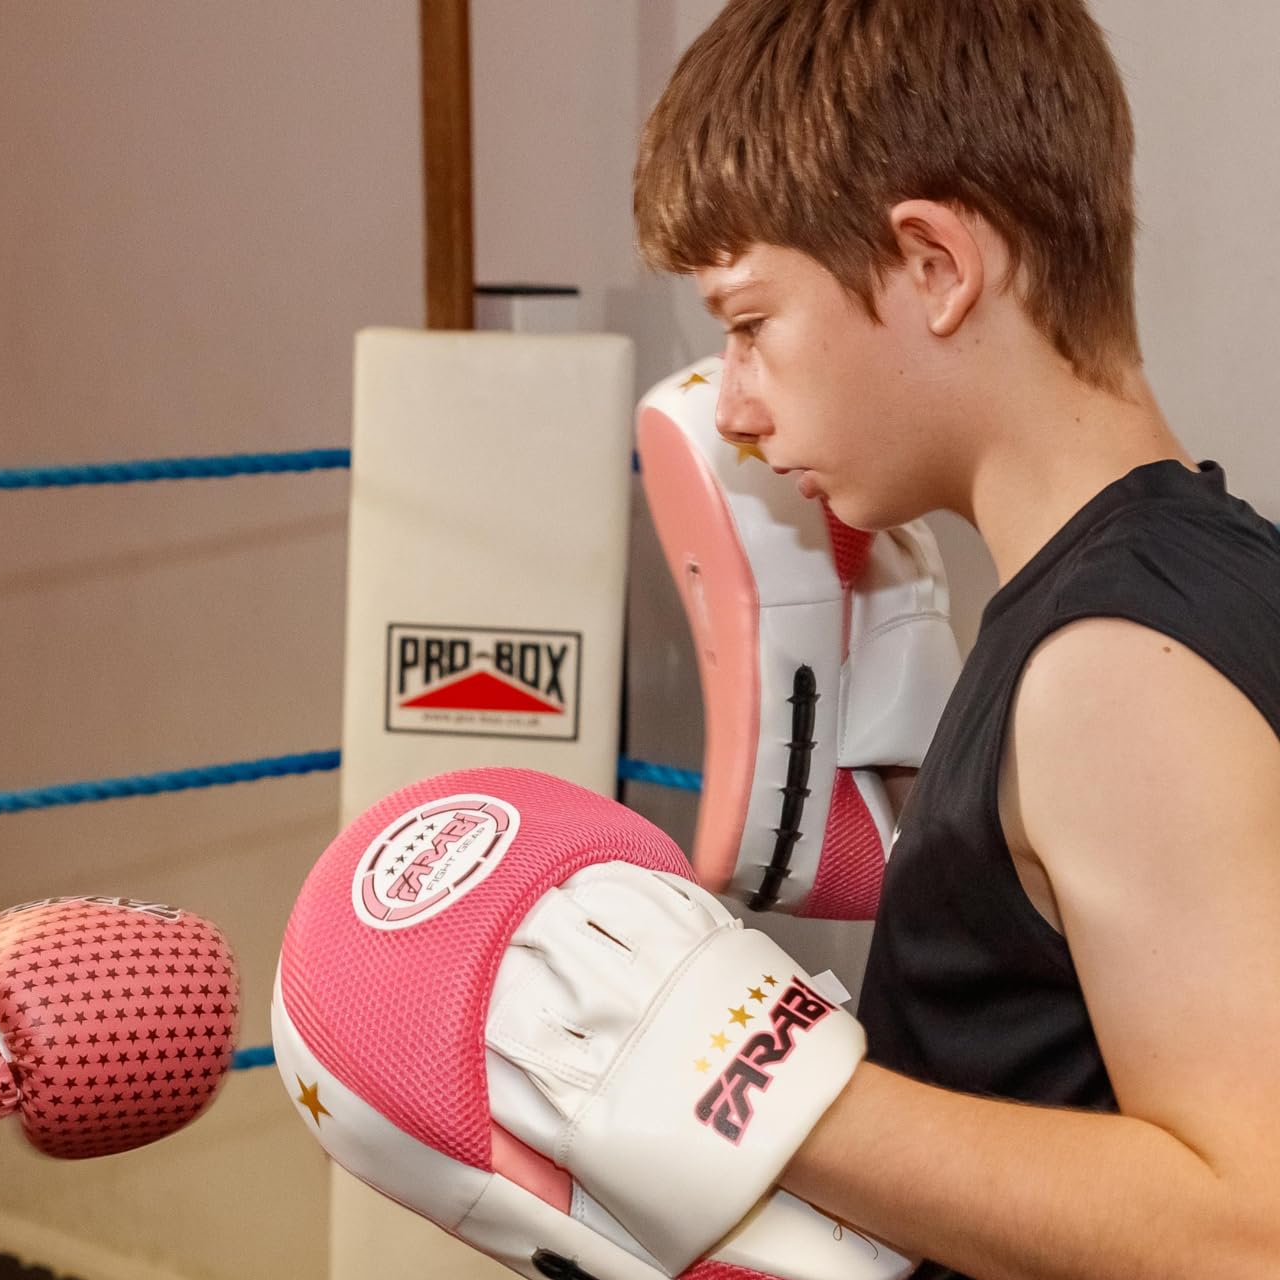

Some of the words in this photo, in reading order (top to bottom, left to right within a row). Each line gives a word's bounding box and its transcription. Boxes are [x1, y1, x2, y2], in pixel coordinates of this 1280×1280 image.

[397, 636, 567, 704] PRO-BOX
[385, 812, 489, 902] FARABI
[426, 856, 456, 890] FIGHT
[456, 827, 485, 853] GEAR
[694, 974, 840, 1147] FARABI
